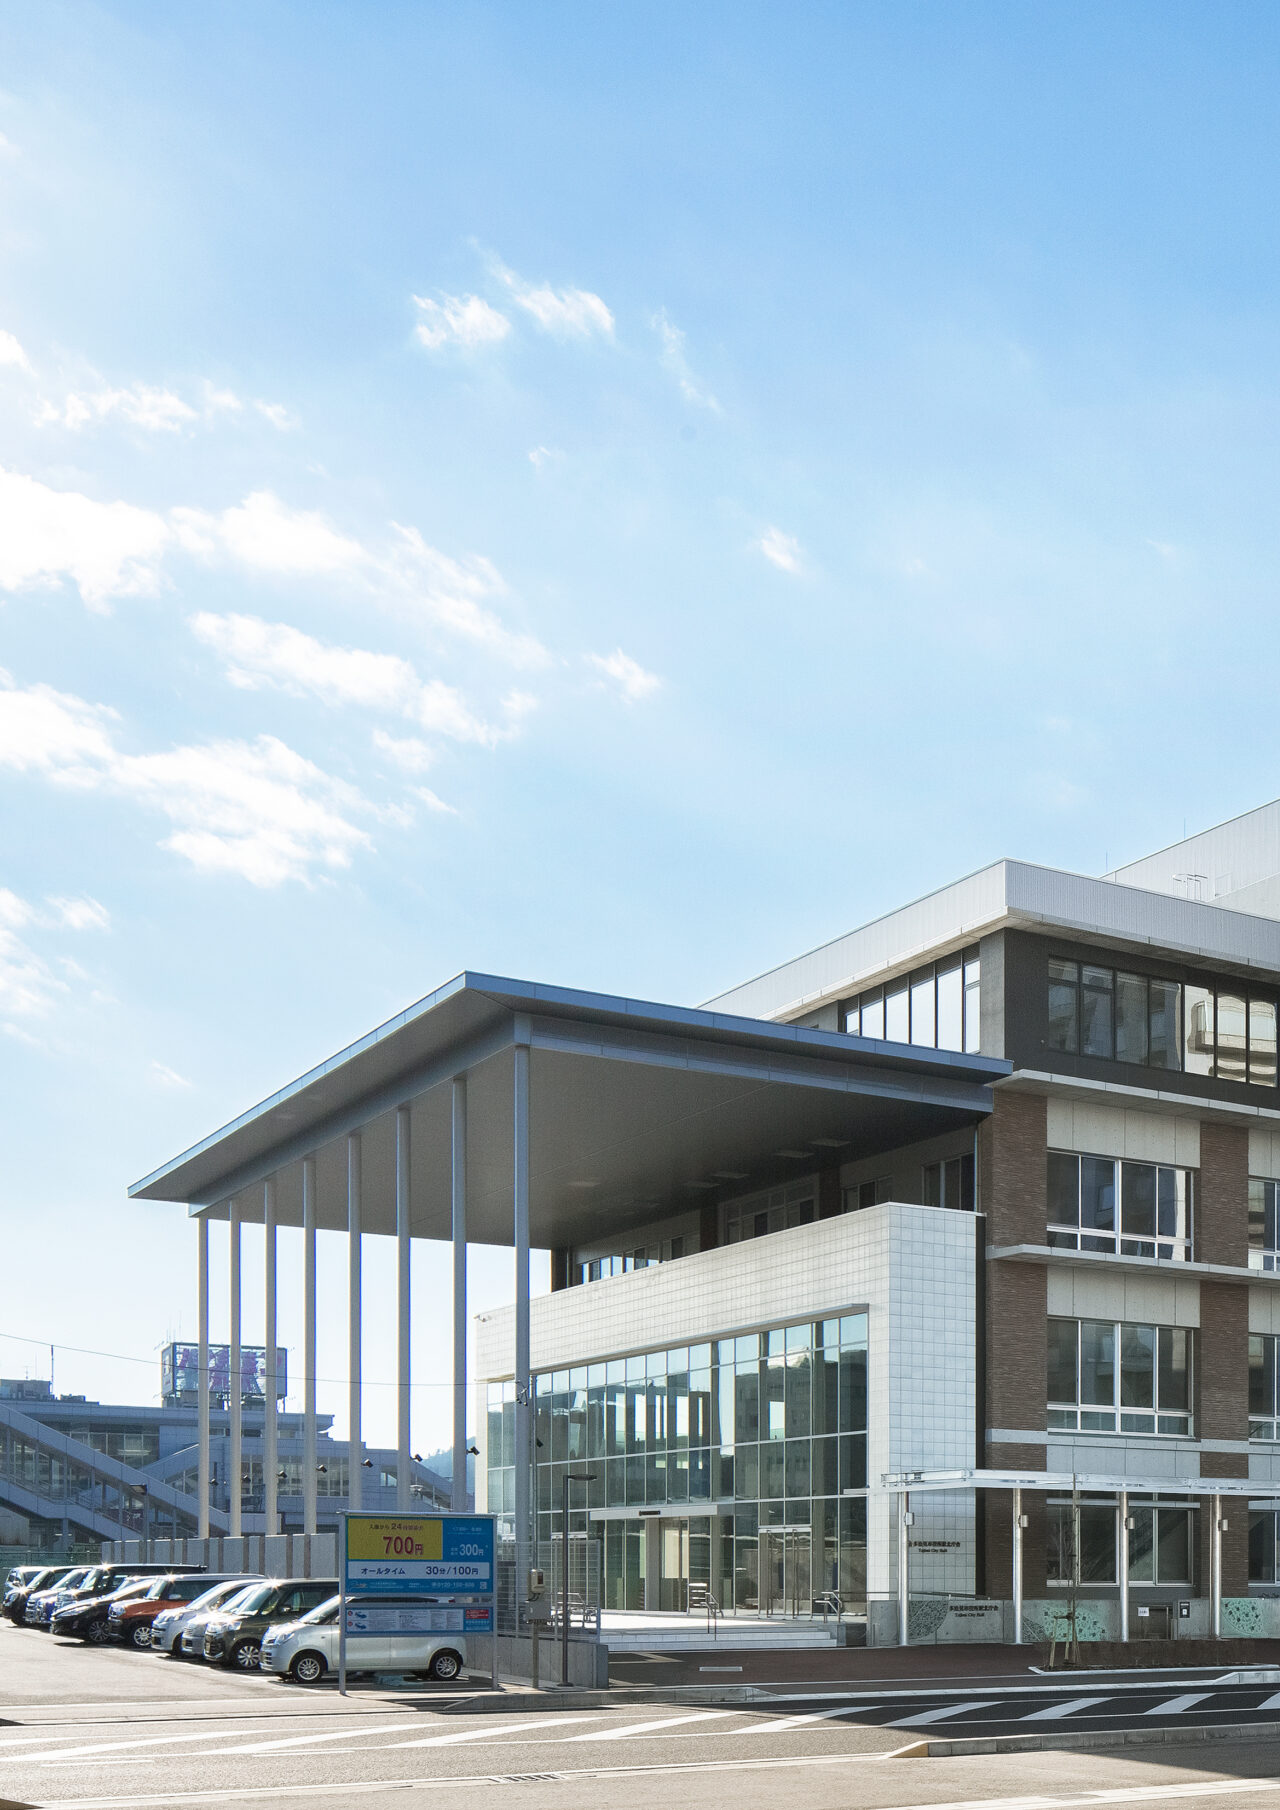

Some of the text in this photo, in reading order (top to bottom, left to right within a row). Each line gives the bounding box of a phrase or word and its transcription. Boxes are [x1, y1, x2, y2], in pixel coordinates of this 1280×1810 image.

[383, 1536, 424, 1556] 700円
[459, 1544, 484, 1556] 300円
[360, 1567, 406, 1575] オールタイム
